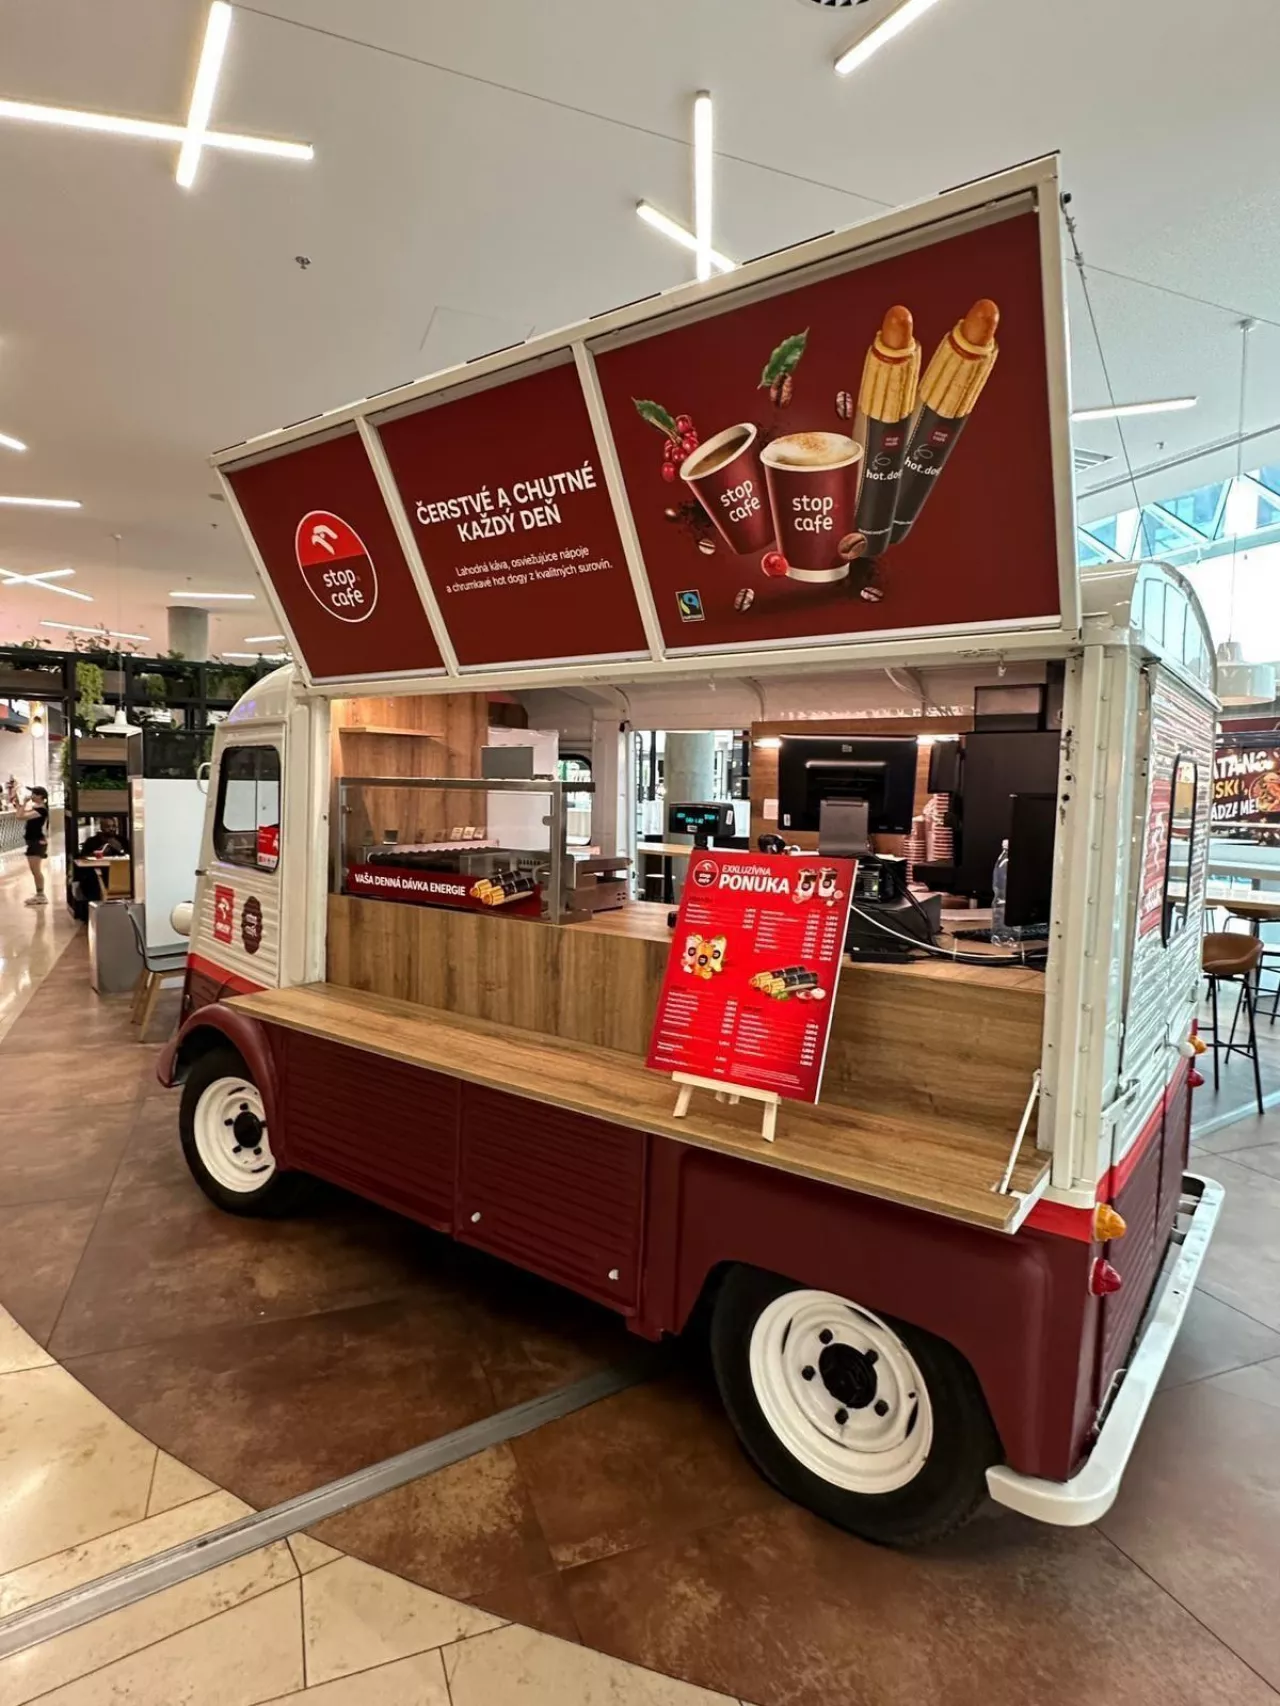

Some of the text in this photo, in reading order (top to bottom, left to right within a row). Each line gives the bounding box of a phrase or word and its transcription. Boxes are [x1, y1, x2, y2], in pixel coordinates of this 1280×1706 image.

[416, 460, 597, 525] ČERSTVÉ A CHUTNÉ
[720, 480, 753, 507] stop
[792, 495, 833, 515] stop
[457, 498, 562, 542] KAŽDÝ DEŇ
[729, 496, 761, 522] cafe
[794, 514, 833, 533] cafe
[455, 545, 589, 577] Lahodná káva, osviežujúce nápoje
[323, 569, 356, 589] stop
[446, 558, 613, 593] a chrumkavé hot dogy z kvalitných surovín.
[331, 587, 364, 607] cafe
[355, 872, 466, 896] VAŠA DENNÁ DÁVKA ENERGIE
[718, 873, 790, 895] PONUKA
